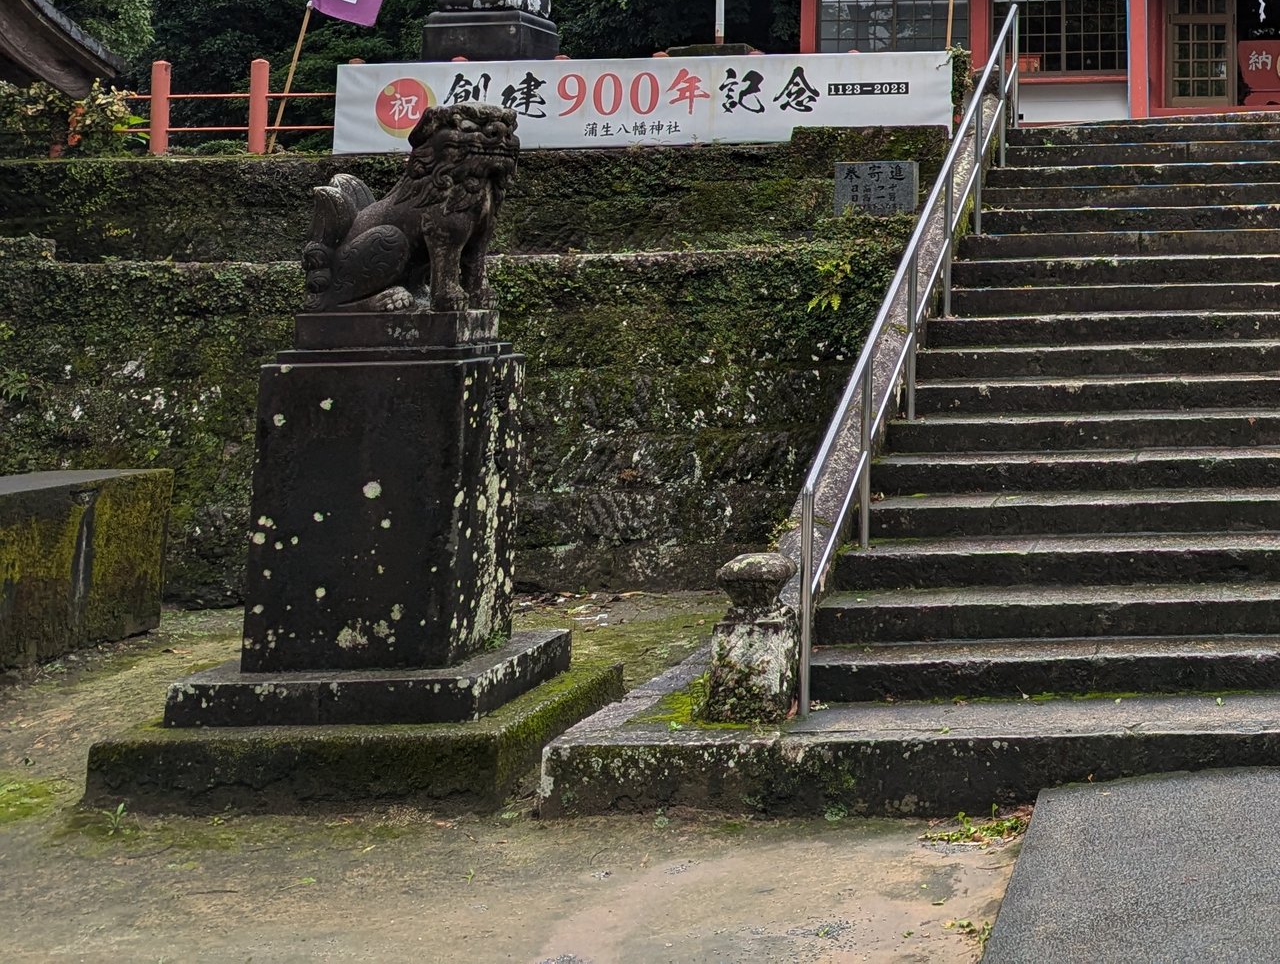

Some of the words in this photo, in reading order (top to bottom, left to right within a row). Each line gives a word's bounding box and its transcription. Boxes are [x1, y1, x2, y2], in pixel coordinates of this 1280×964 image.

[1249, 50, 1273, 72] 納
[444, 66, 820, 119] 創建900年記念
[389, 94, 420, 121] 祝
[584, 121, 681, 138] 蒲生八幡神社
